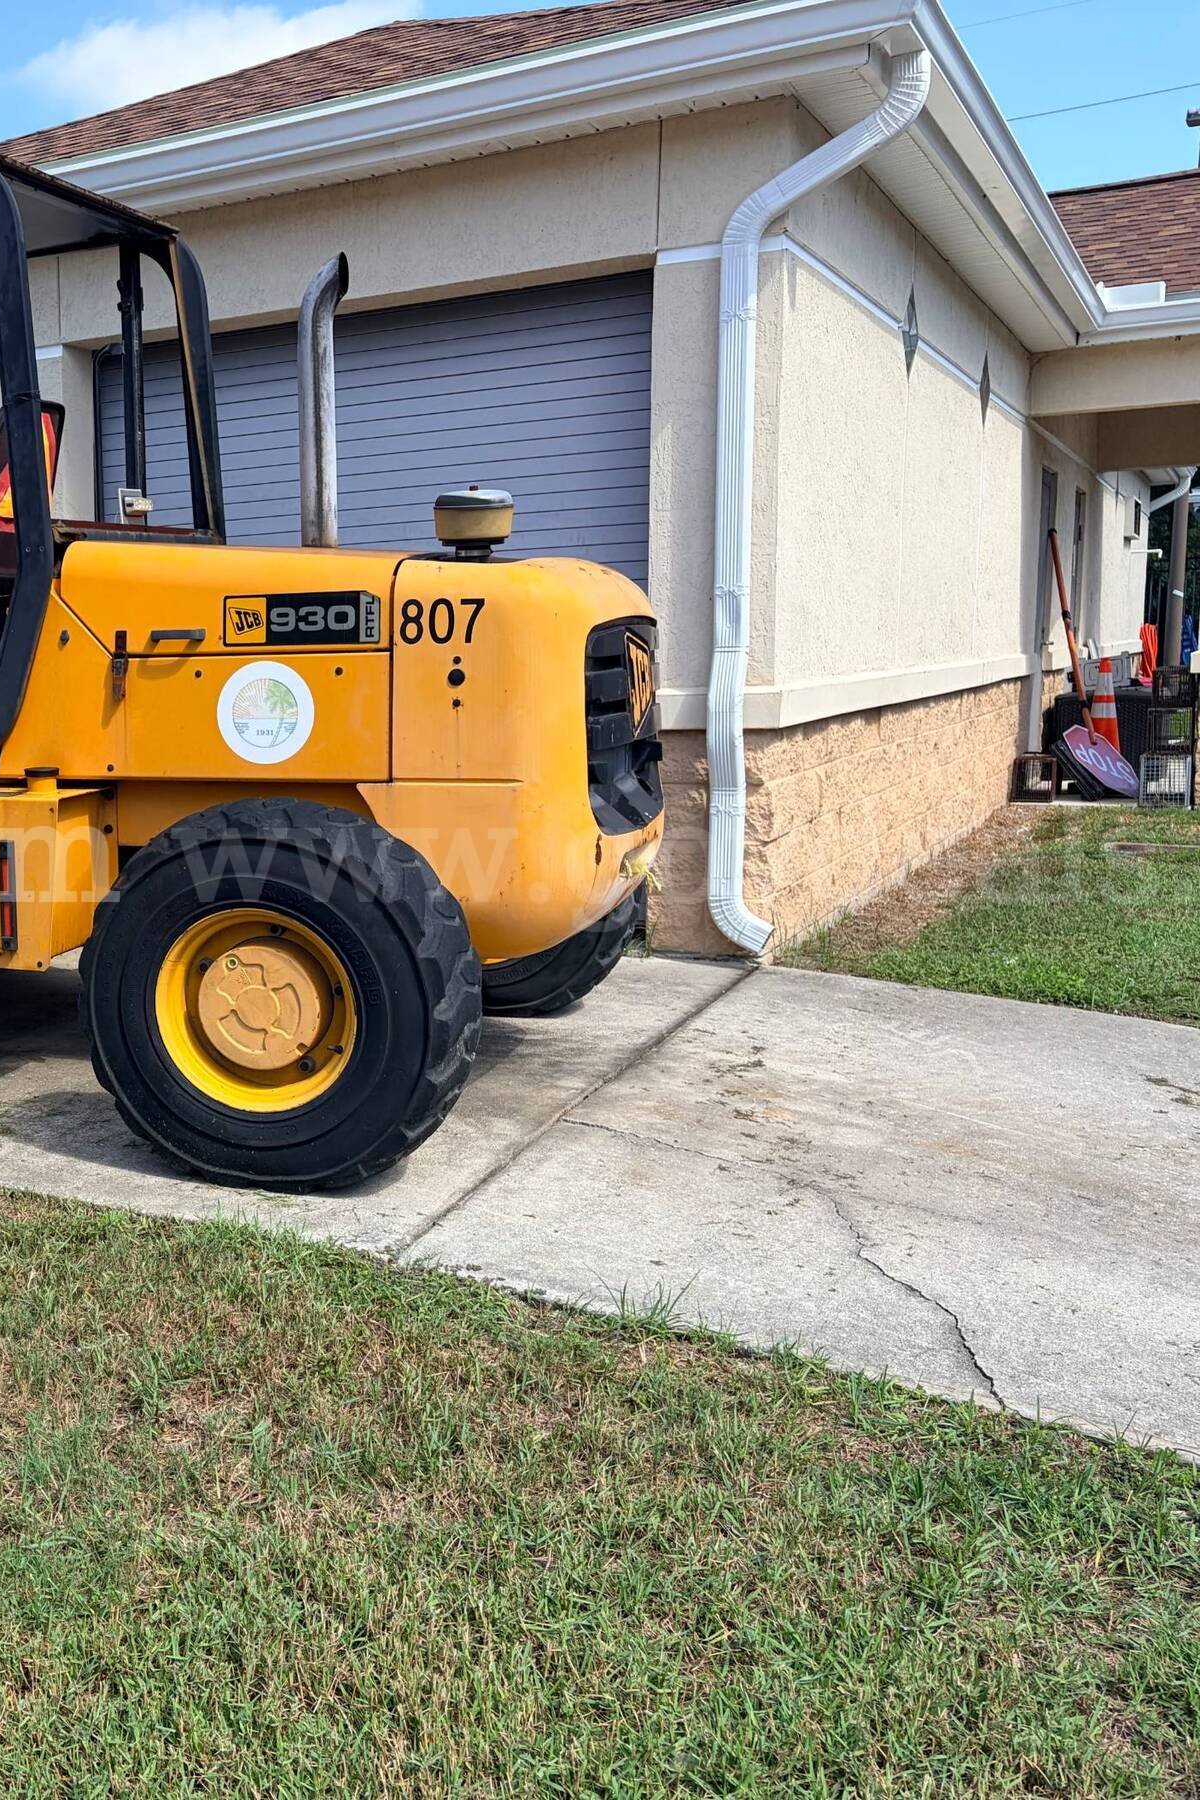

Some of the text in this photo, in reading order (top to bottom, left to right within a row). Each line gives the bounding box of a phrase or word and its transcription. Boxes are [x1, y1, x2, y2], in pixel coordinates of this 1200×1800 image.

[234, 604, 356, 633] JCB 930
[364, 595, 376, 638] RTFL
[399, 597, 486, 645] 807
[628, 641, 652, 730] JCB
[1075, 743, 1136, 785] STOP
